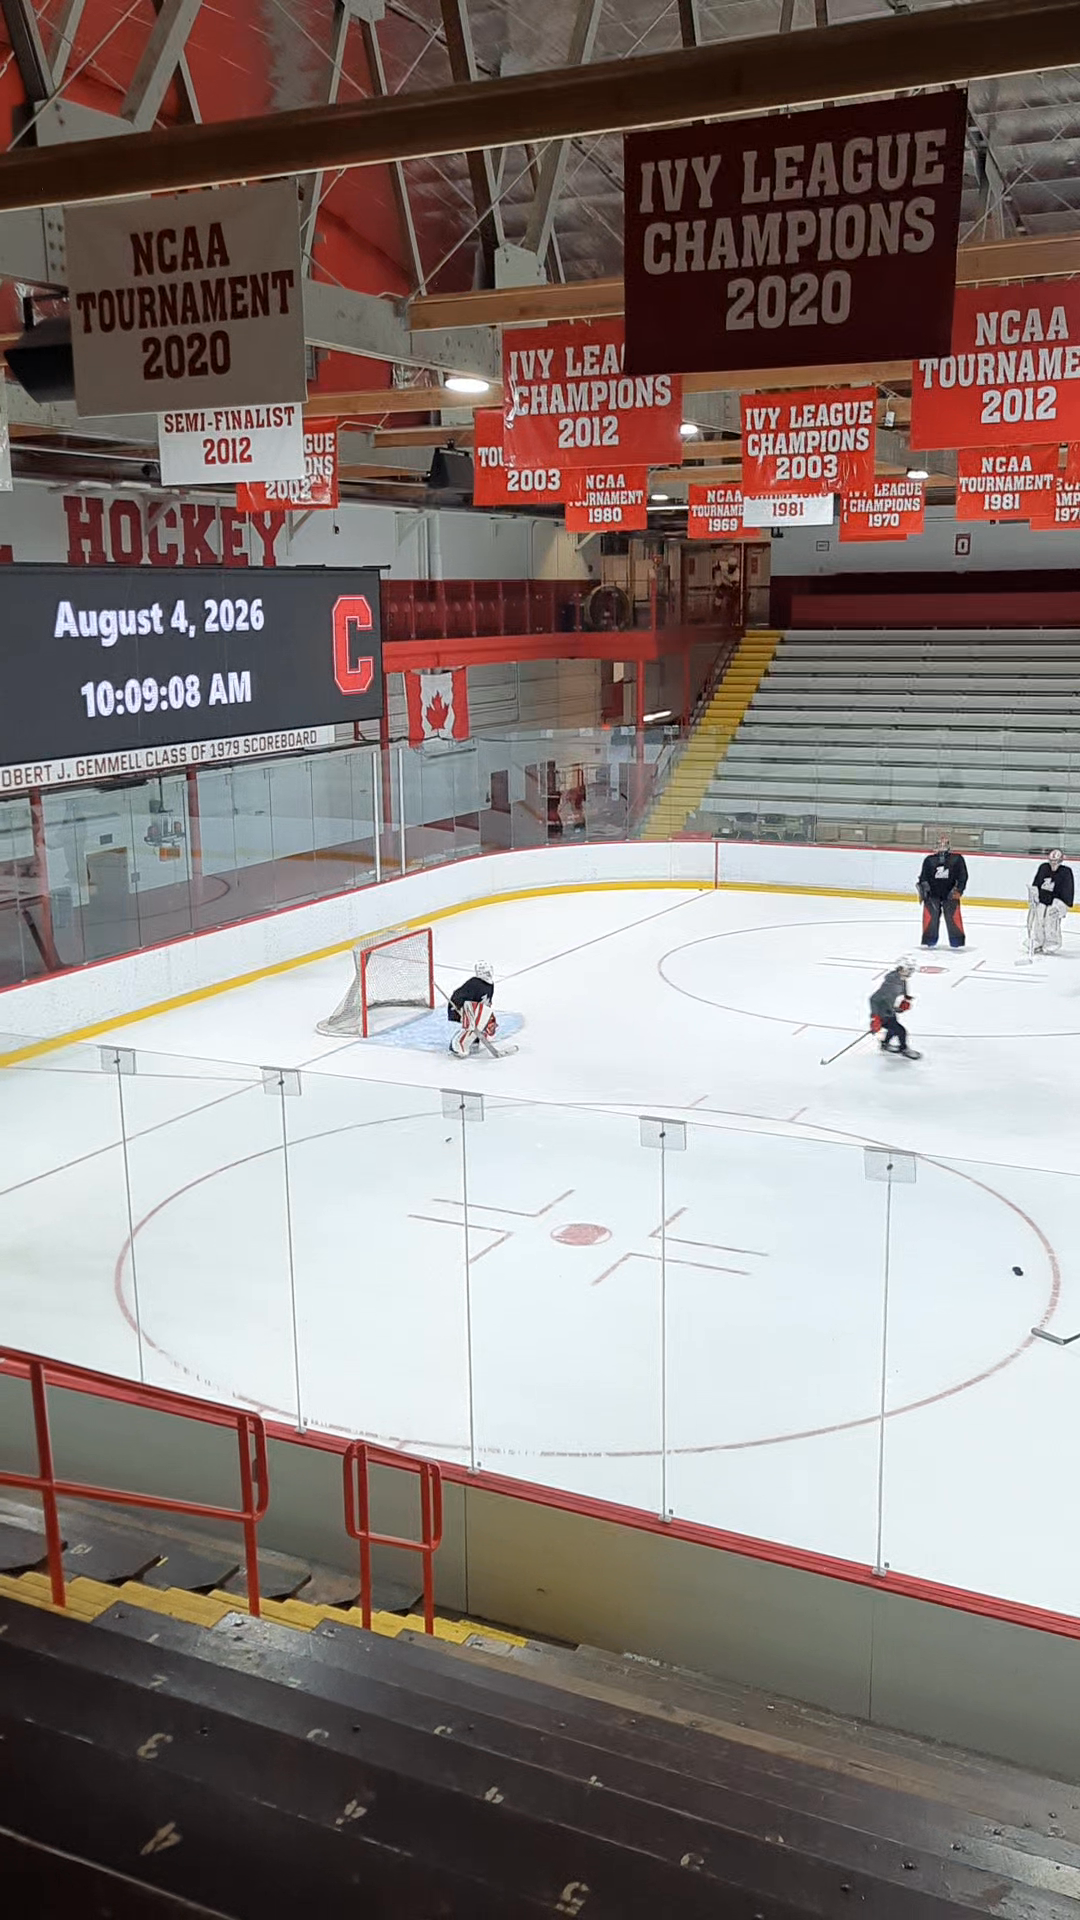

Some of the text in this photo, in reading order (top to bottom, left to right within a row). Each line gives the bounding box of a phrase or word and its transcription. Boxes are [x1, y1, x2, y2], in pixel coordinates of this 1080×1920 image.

[639, 128, 946, 213] IVY LEAGUE
[130, 222, 230, 277] NCAA
[643, 196, 935, 275] CHAMPIONS
[76, 270, 294, 334] TOURNAMENT
[725, 269, 851, 331] 2020
[975, 306, 1069, 347] NCAA
[142, 330, 231, 380] 2020
[509, 342, 625, 381] IVY LEA
[919, 345, 1080, 389] TOURNAME
[515, 375, 671, 416] CHAMPIONS
[981, 386, 1057, 424] 2012
[164, 406, 295, 433] SEMI-FINALIST
[558, 415, 619, 449] 2012
[745, 401, 874, 431] IVY LEAGUE
[203, 437, 252, 464] 2012
[747, 428, 870, 456] CHAMPIONS
[507, 468, 561, 492] 2003
[776, 455, 838, 480] 2003
[981, 455, 1032, 473] NCAA
[586, 473, 625, 489] NCAA
[707, 490, 742, 503] NCAA
[874, 482, 922, 497] LEAGUE
[959, 474, 1054, 493] TOURNAMENT
[588, 507, 622, 523] 1980
[772, 502, 804, 517] 1981
[849, 498, 921, 513] CHAMPIONS
[984, 493, 1020, 510] 1981
[64, 496, 285, 567] HOCKEY
[708, 518, 738, 532] 1969
[868, 513, 899, 528] 1970
[54, 598, 265, 647] August 4, 2026
[331, 594, 375, 695] C
[80, 671, 252, 718] 10:09:08 AM
[57, 763, 71, 780] J.
[75, 754, 142, 777] GEMMELL
[146, 749, 187, 767] CLASS
[191, 745, 206, 761] OF
[210, 740, 240, 759] 1979
[243, 730, 318, 754] SCOREBOARD
